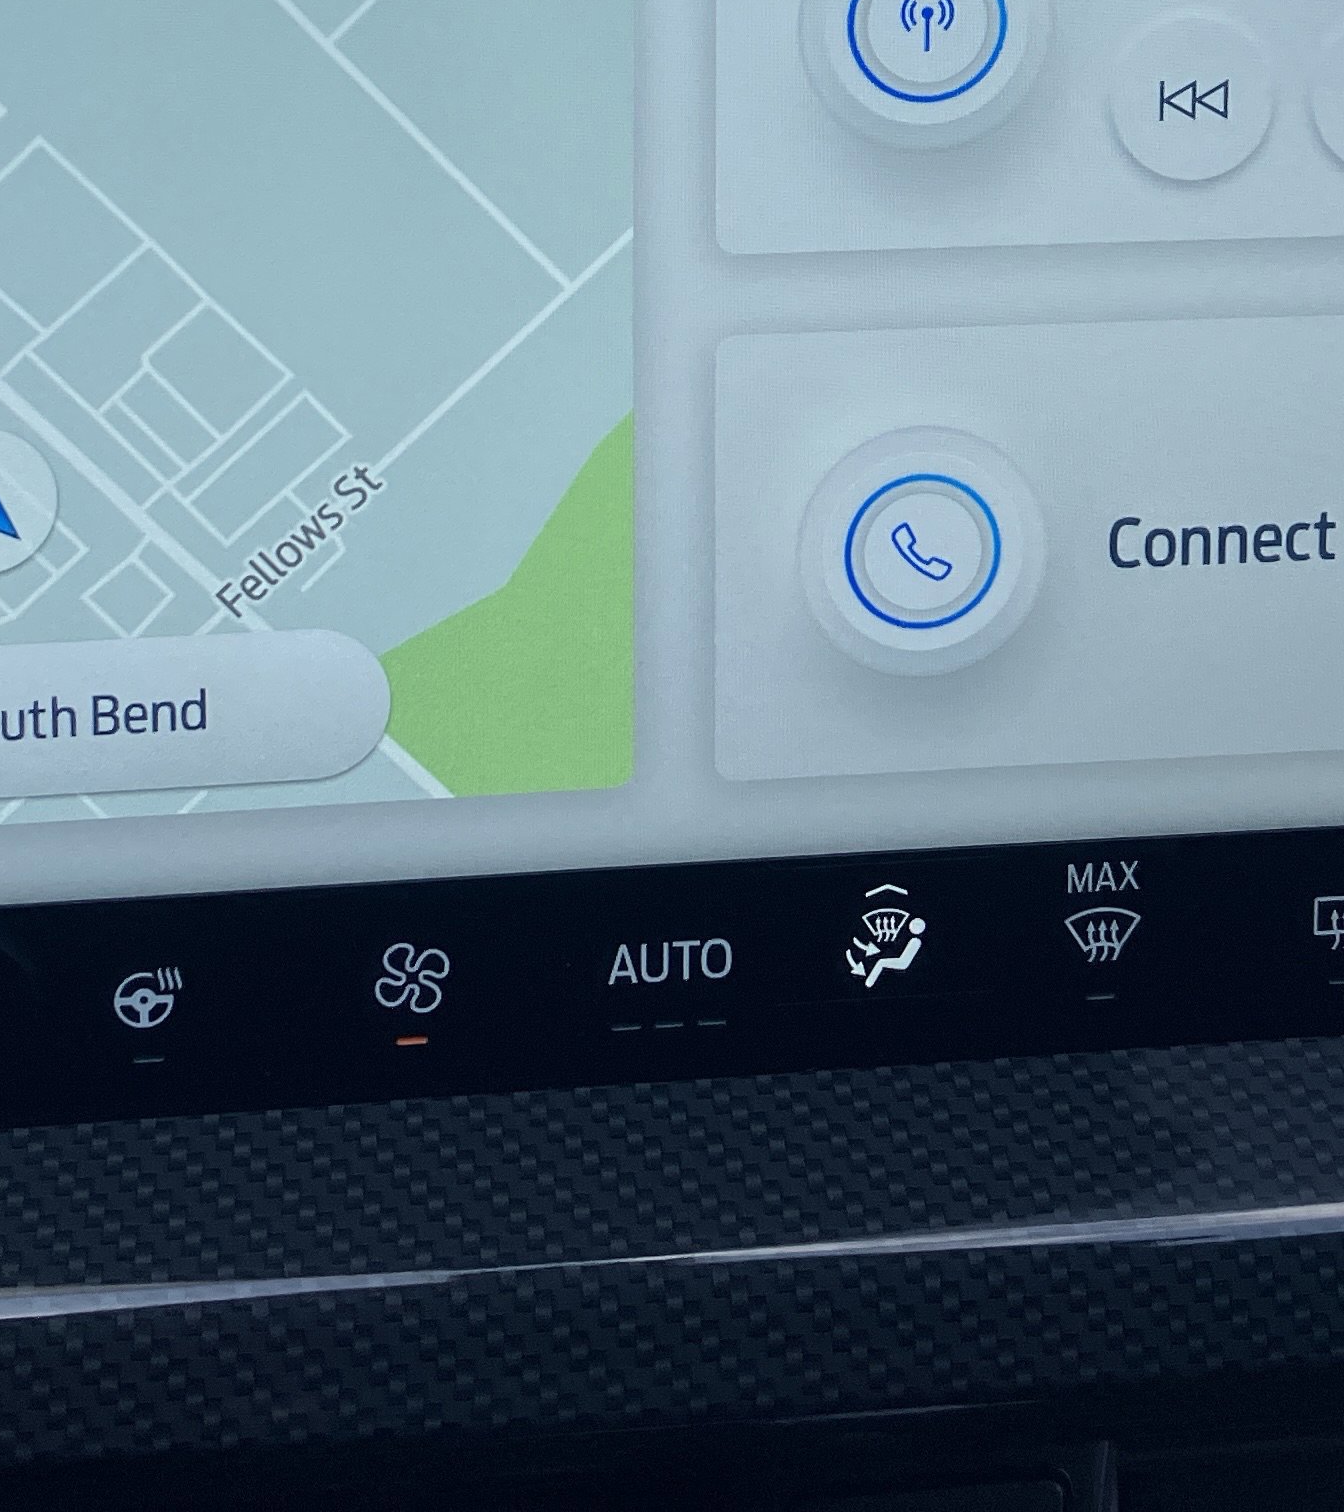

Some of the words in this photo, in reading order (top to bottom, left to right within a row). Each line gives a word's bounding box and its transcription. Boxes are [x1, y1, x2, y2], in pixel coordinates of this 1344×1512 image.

[215, 503, 344, 619] Fellows
[333, 465, 384, 511] St
[1108, 510, 1338, 570] Connect
[90, 687, 208, 737] Bend
[1067, 860, 1140, 894] MAX
[607, 938, 734, 986] AUTO
